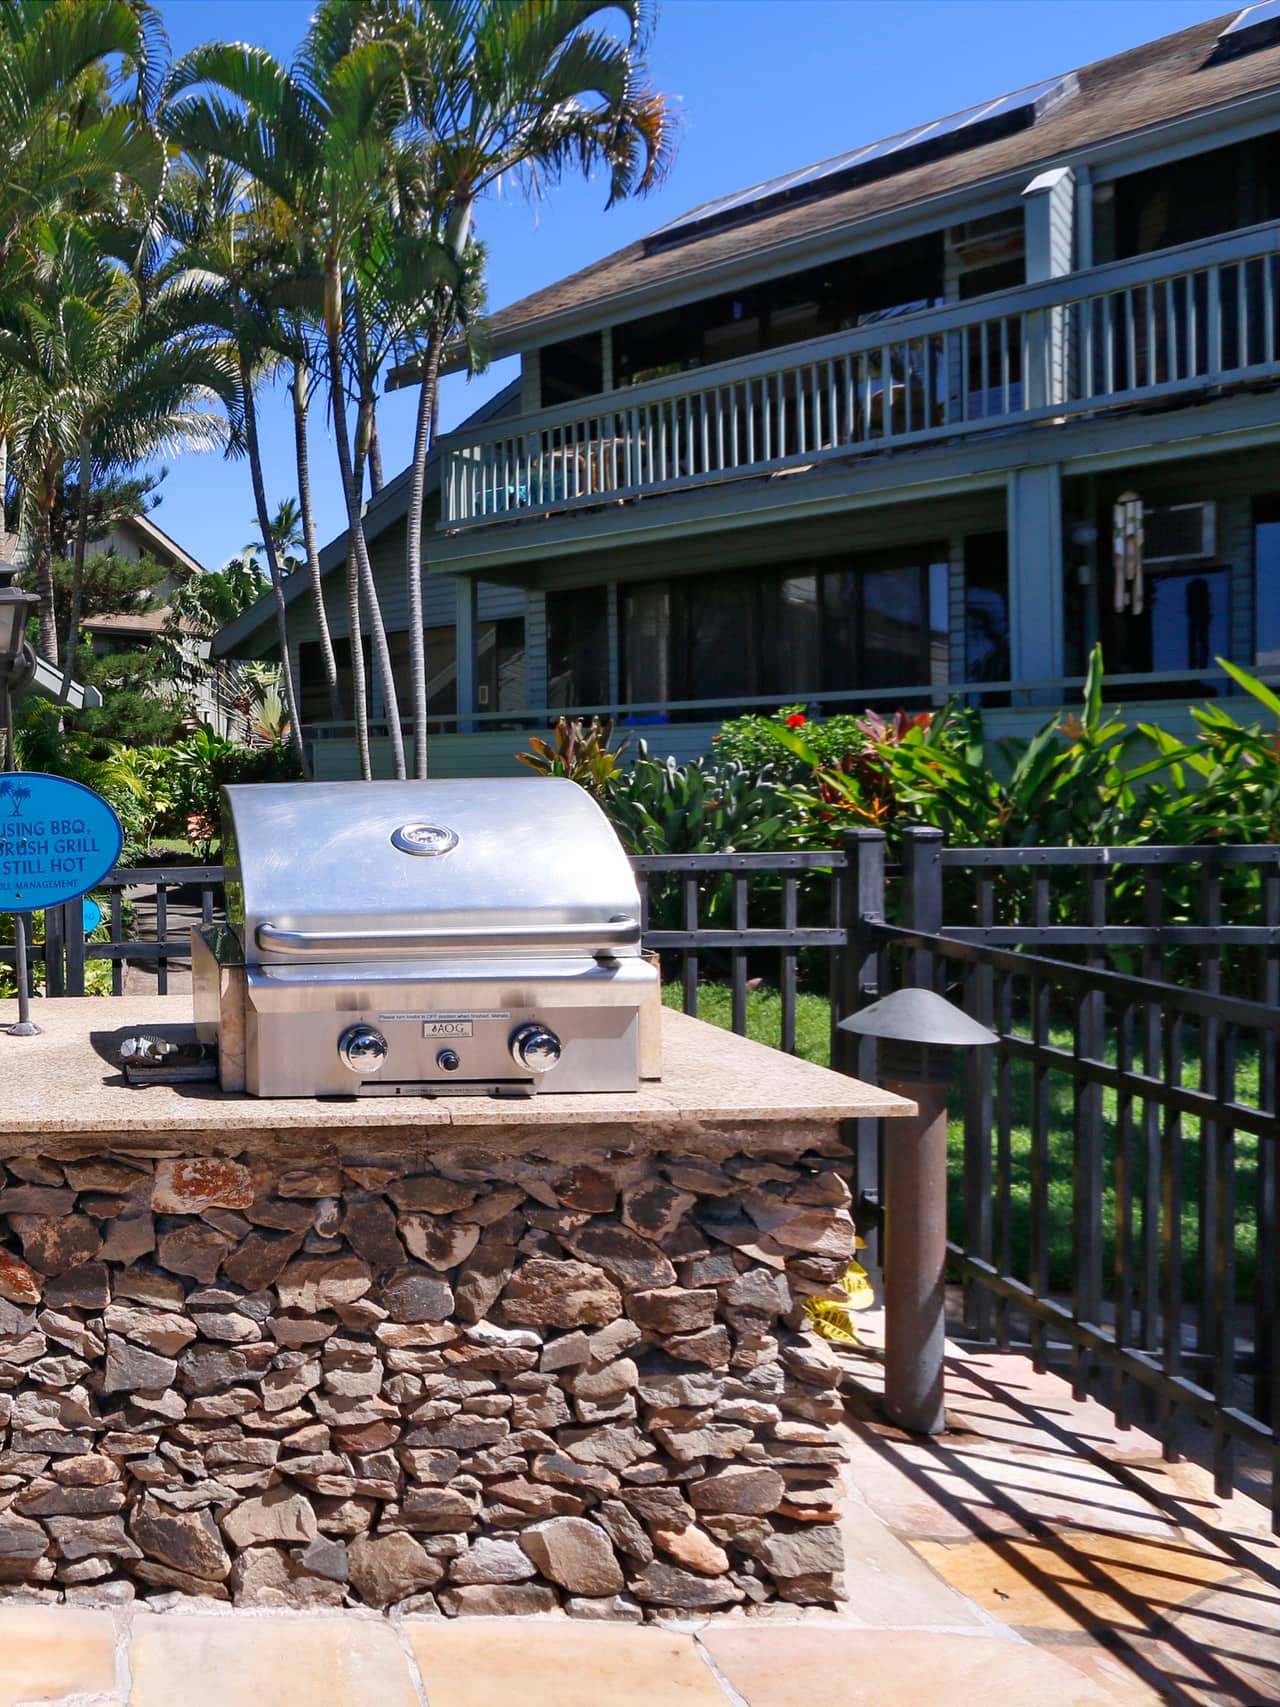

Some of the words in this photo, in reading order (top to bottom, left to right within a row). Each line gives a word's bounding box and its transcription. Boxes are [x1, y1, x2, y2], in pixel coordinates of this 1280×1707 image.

[51, 819, 91, 835] BBQ,
[55, 838, 99, 853] GRILL
[3, 860, 45, 875] STILL
[51, 857, 86, 872] HOT
[16, 879, 78, 890] MANAGEMENT
